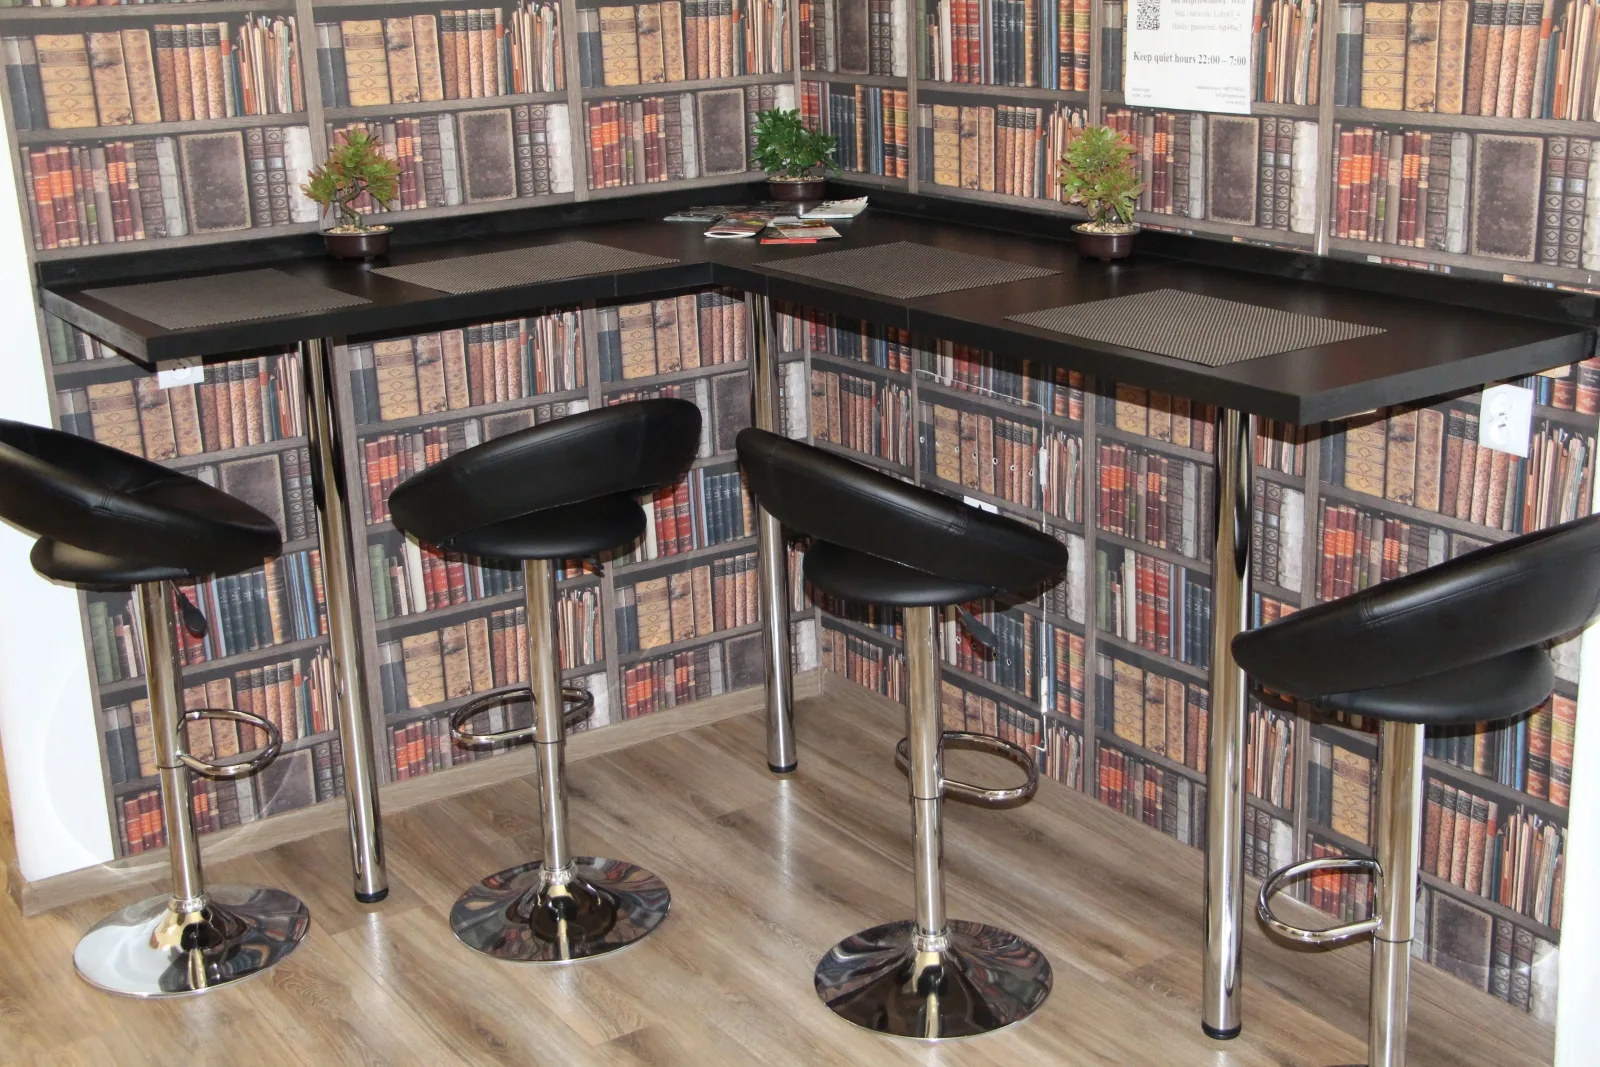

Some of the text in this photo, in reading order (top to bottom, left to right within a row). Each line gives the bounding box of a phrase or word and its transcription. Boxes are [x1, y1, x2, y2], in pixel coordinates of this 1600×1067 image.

[1133, 51, 1152, 64] Keep
[1153, 52, 1173, 64] quiet
[1174, 53, 1196, 64] hours
[1198, 54, 1220, 65] 22:00
[1229, 55, 1247, 66] 7:00
